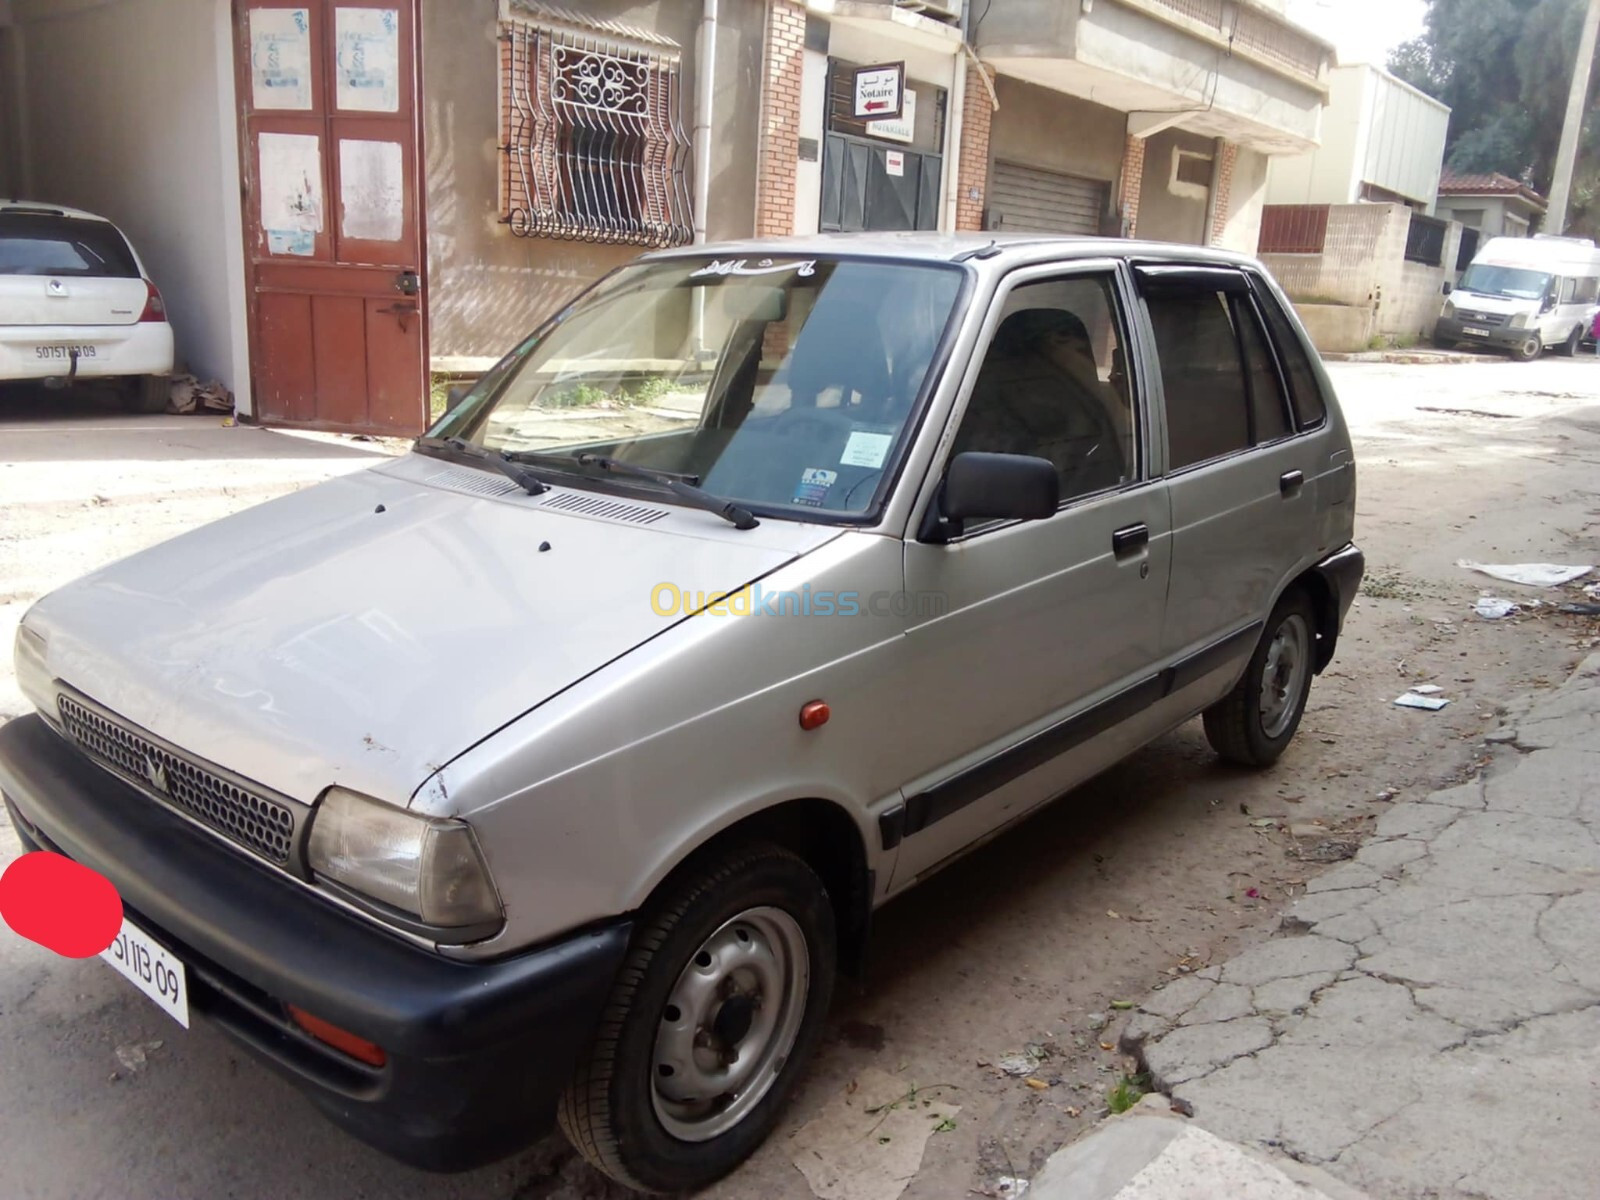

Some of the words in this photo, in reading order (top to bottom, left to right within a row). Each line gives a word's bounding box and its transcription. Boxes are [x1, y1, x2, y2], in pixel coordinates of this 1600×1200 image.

[860, 88, 893, 99] Notaire
[36, 346, 66, 358] 50757
[83, 345, 96, 357] 09
[108, 934, 129, 966] 51
[131, 940, 152, 983] 113
[156, 961, 179, 1005] 09
